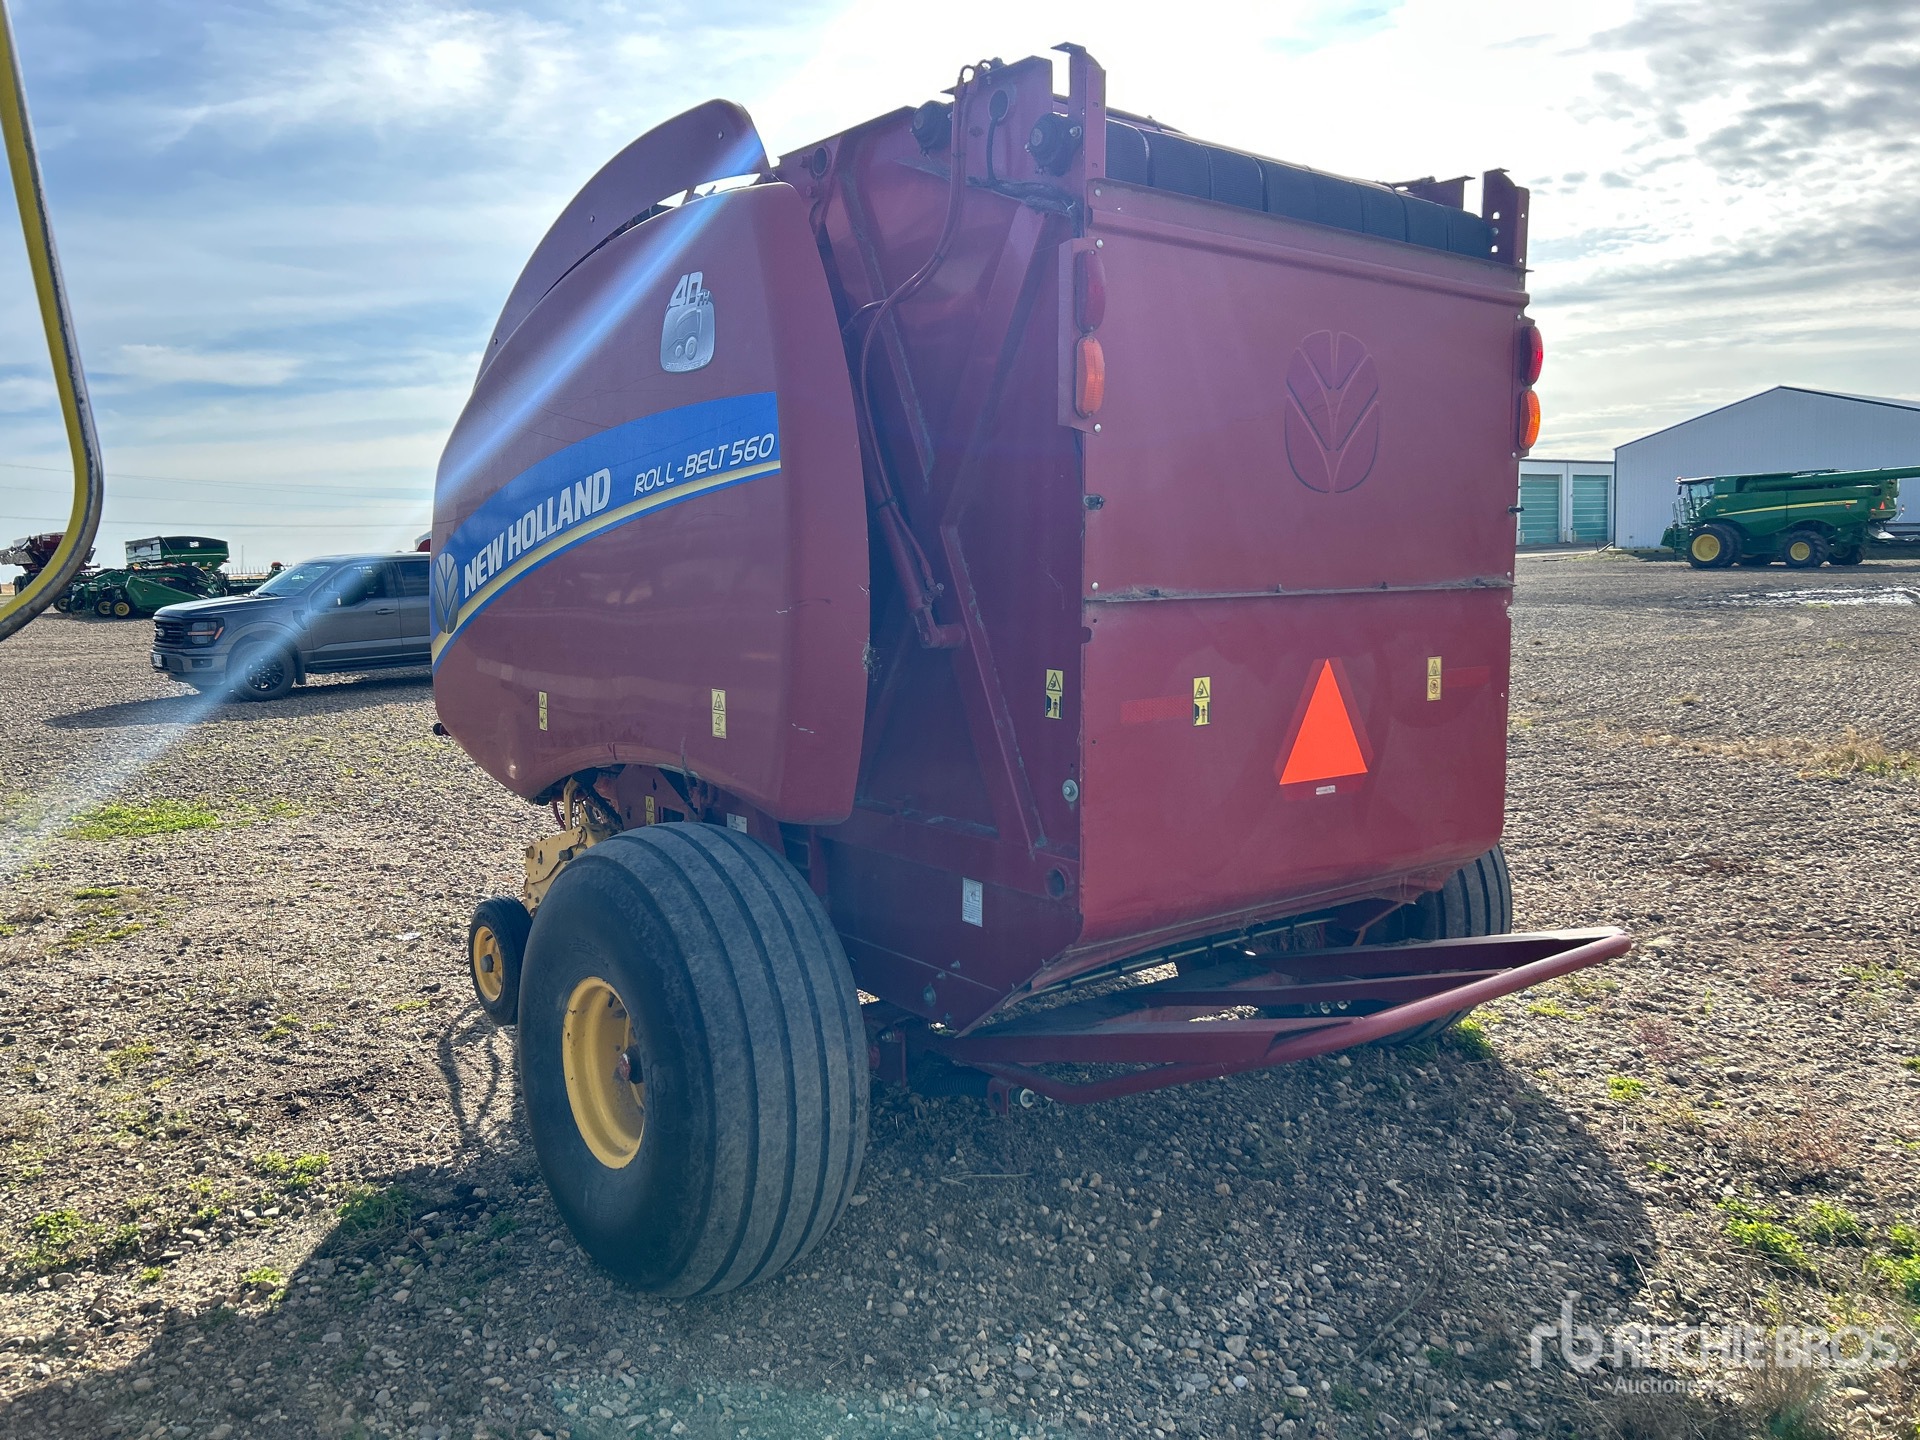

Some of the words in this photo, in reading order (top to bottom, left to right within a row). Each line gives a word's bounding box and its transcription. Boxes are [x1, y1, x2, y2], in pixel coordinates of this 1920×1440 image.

[633, 443, 729, 496] ROLL-BELT
[730, 433, 775, 466] 560
[464, 532, 505, 599] NEW
[507, 468, 611, 561] HOLLAND
